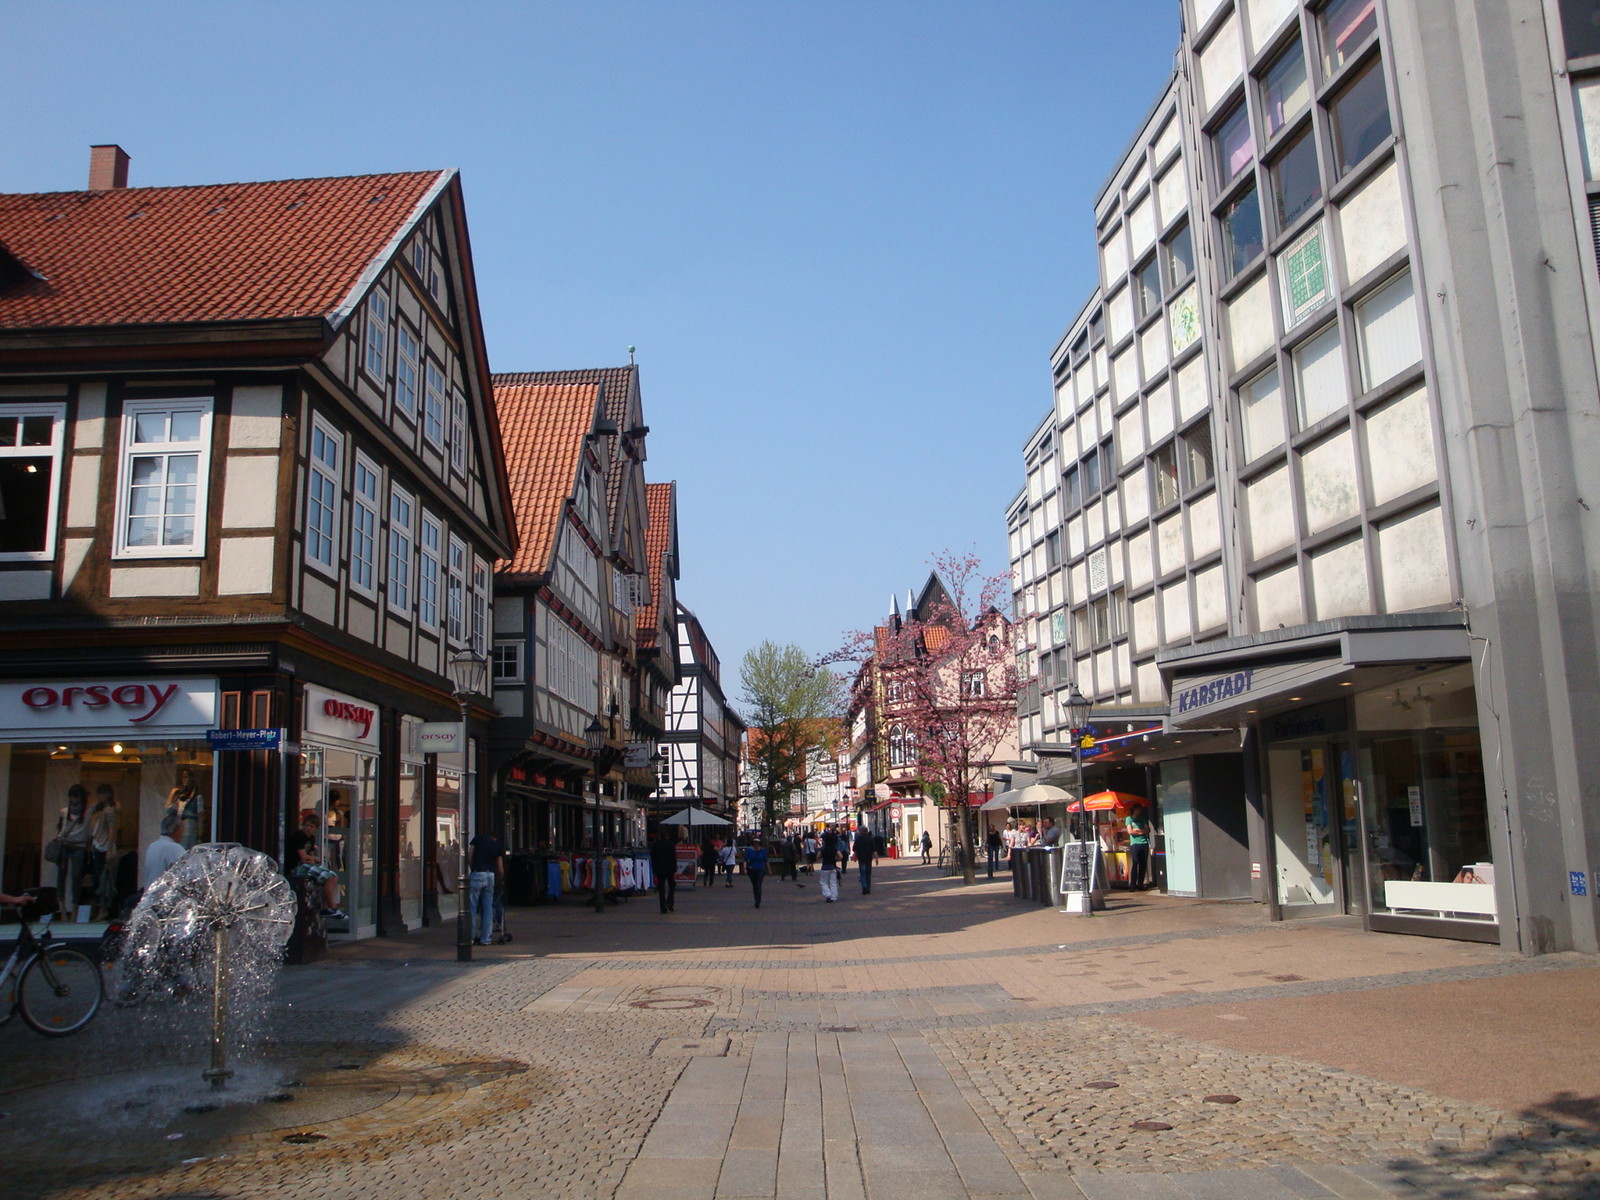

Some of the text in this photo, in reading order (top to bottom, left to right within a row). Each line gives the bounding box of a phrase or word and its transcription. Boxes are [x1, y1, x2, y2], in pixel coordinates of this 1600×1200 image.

[22, 684, 178, 722] orsay
[1179, 669, 1254, 713] KARSTADT
[210, 730, 276, 740] Robert-Meyer-Platz
[324, 699, 374, 738] orsay
[421, 733, 456, 743] orsay
